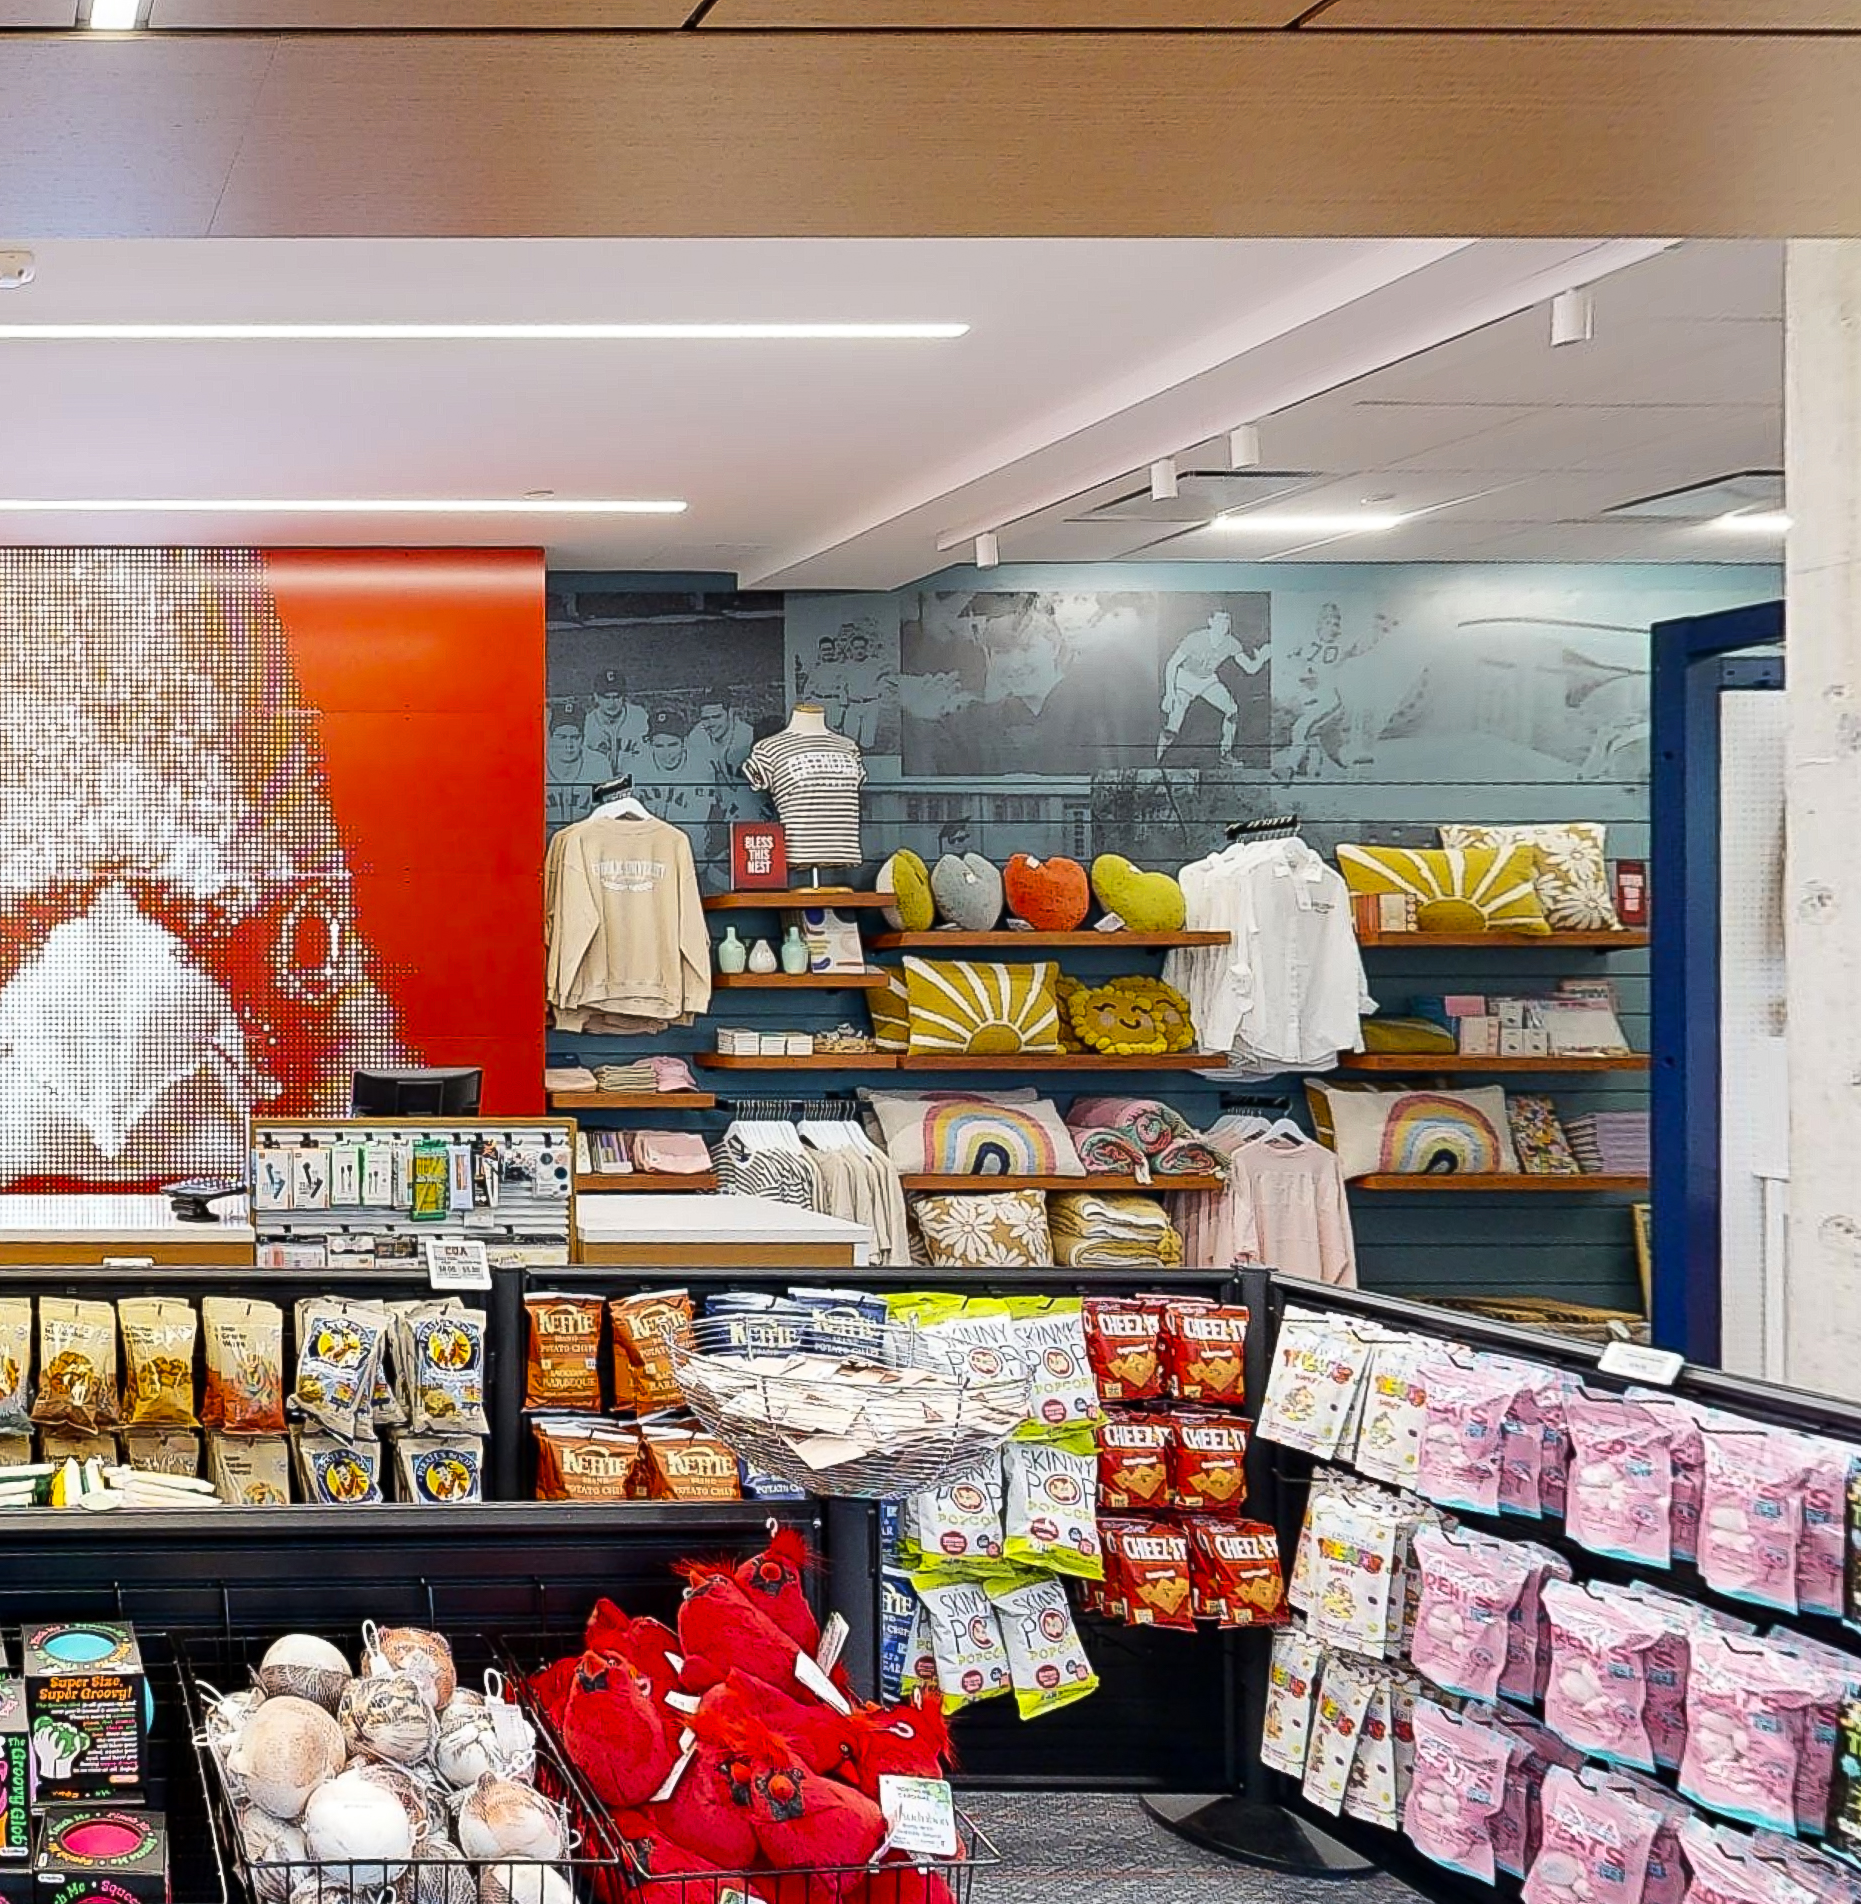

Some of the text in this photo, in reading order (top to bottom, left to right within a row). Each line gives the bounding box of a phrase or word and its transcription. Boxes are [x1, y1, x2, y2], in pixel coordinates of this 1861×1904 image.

[744, 836, 774, 848] BLESS
[748, 848, 771, 860] THIS
[746, 860, 772, 874] NEST
[1014, 1319, 1079, 1349] SKINNY
[1022, 1449, 1095, 1478] SKINNY
[940, 1587, 988, 1618] SKINN
[39, 1685, 134, 1702] Super Groovy!
[50, 1676, 89, 1691] Super
[8, 1737, 26, 1748] The
[9, 1748, 26, 1807] Groovy
[9, 1806, 27, 1848] Glob
[66, 1879, 141, 1904] Me Squee
